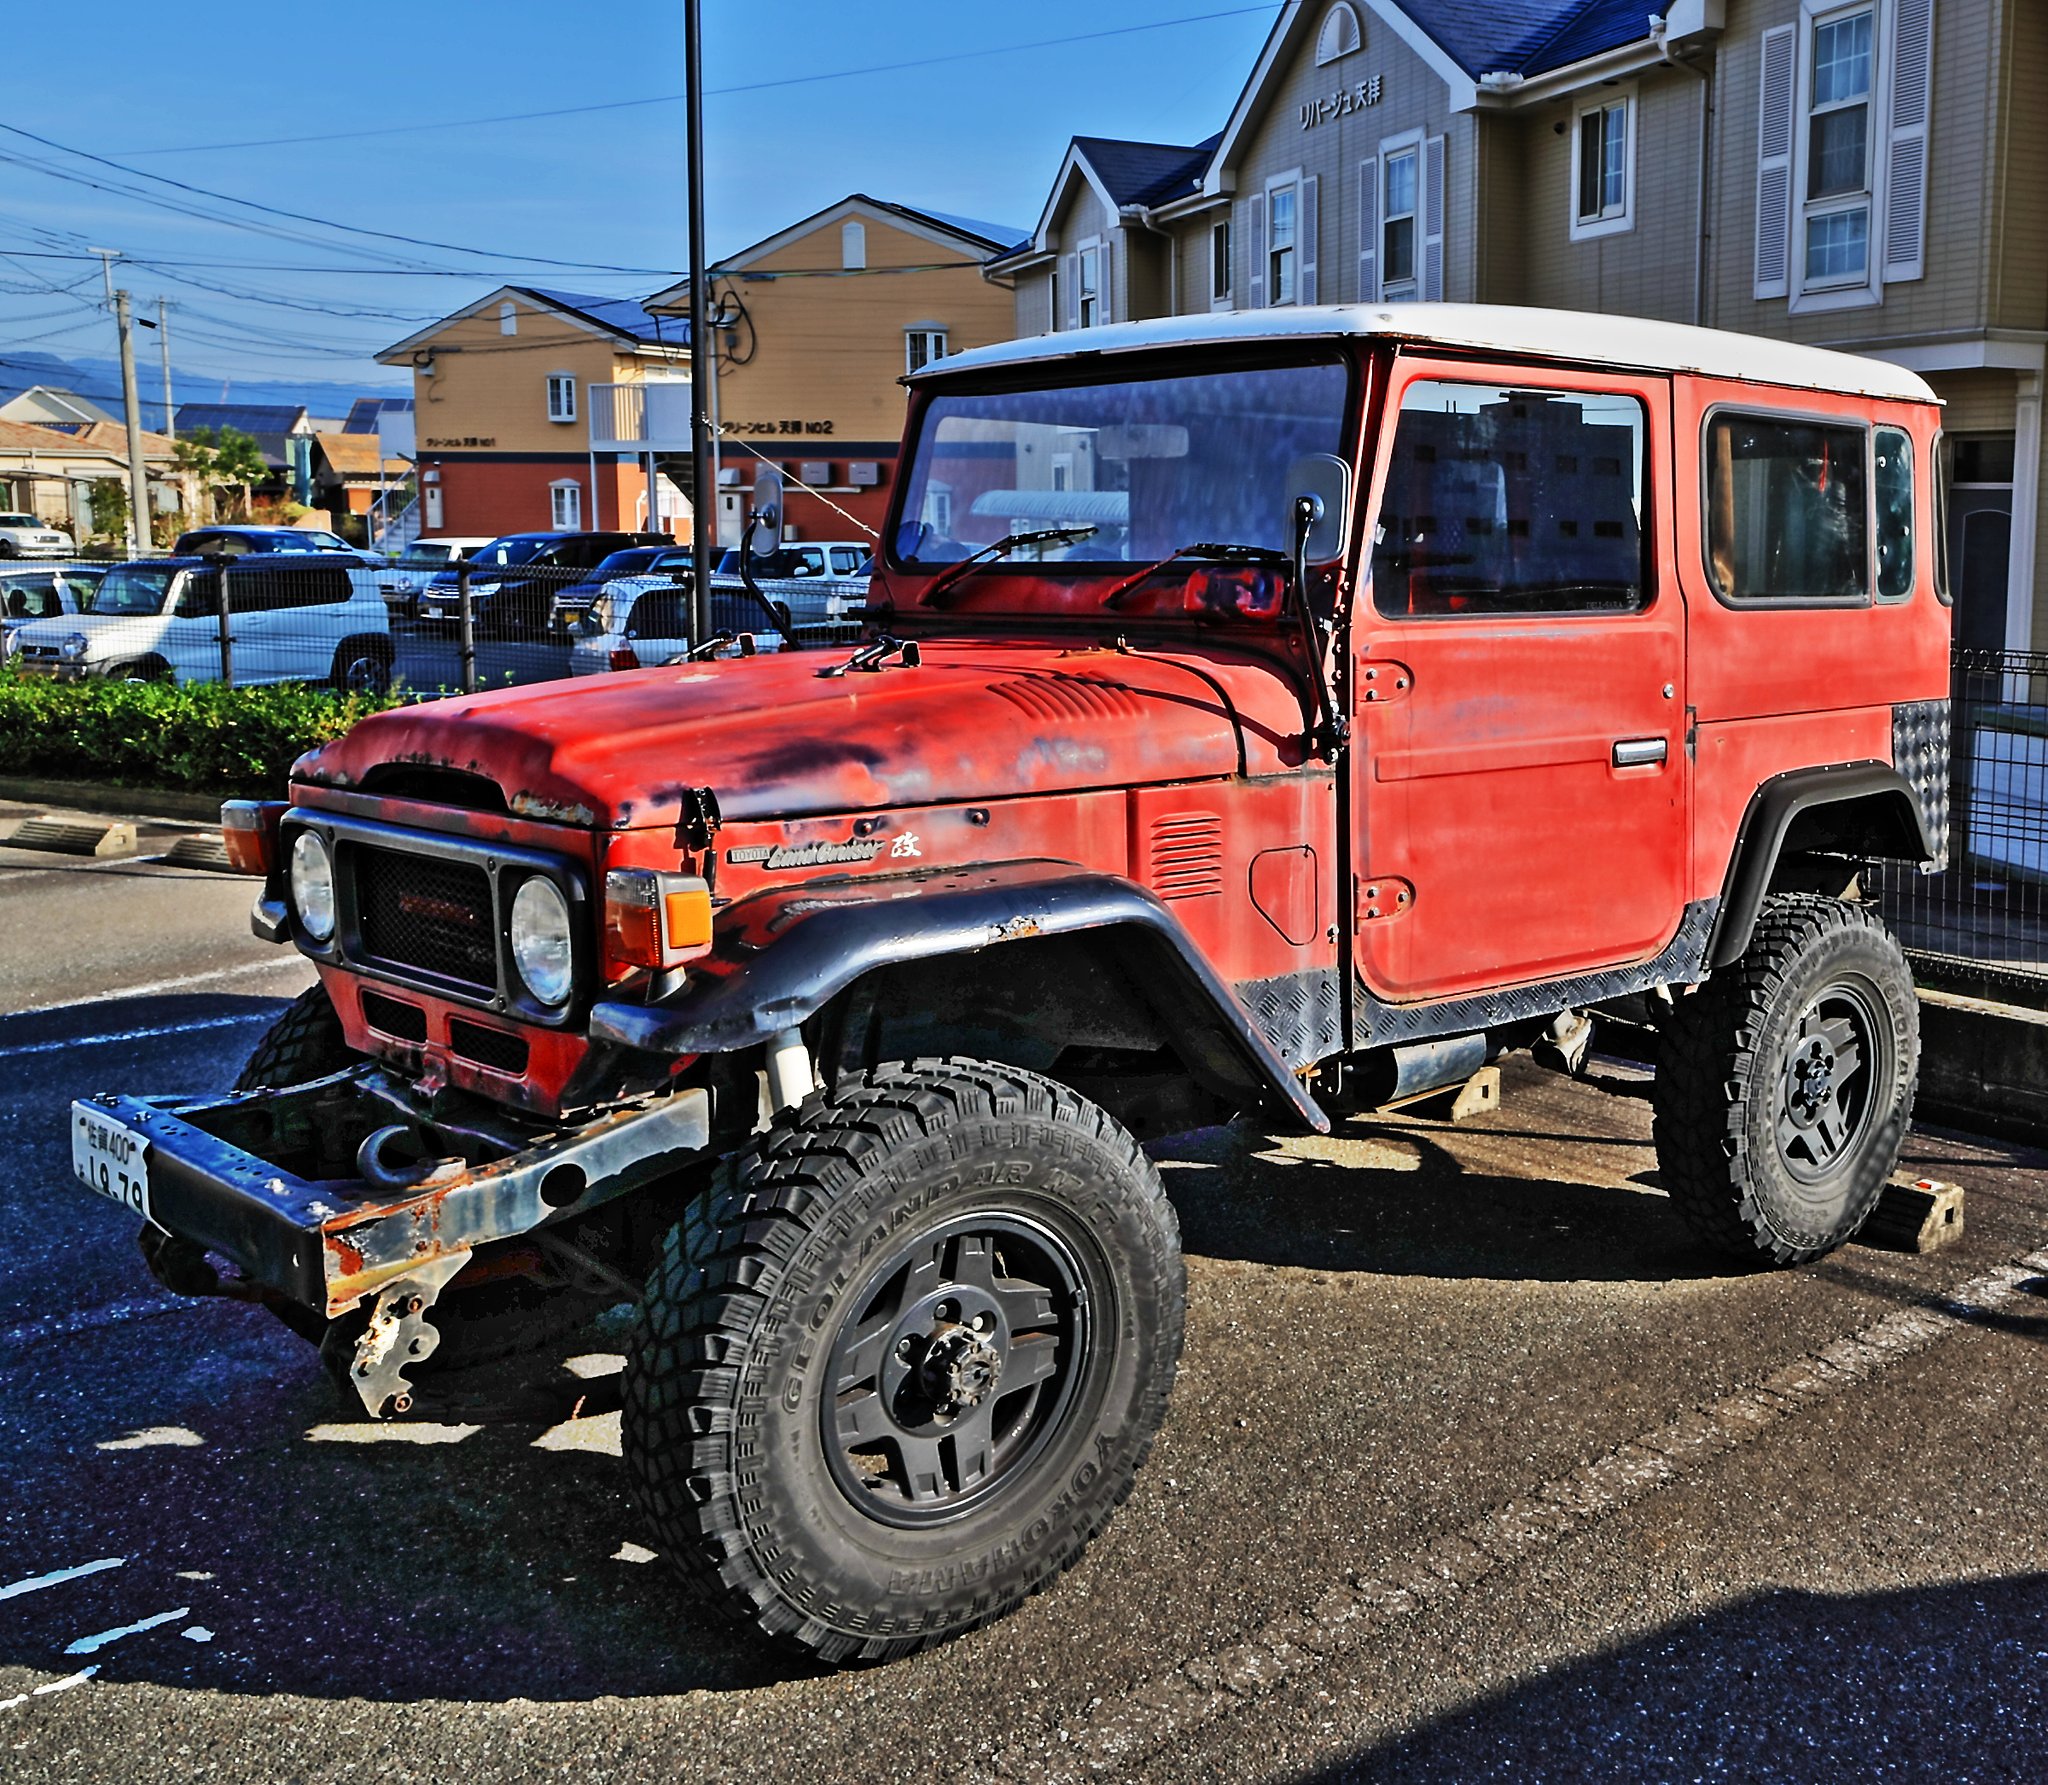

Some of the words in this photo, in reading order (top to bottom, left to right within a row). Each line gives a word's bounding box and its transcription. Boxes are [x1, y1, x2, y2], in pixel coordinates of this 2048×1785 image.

[732, 848, 769, 861] TOYOTA
[891, 831, 922, 858] 改
[783, 1161, 1033, 1414] GEOLANDAR
[889, 1431, 1118, 1595] YOKOHAMA
